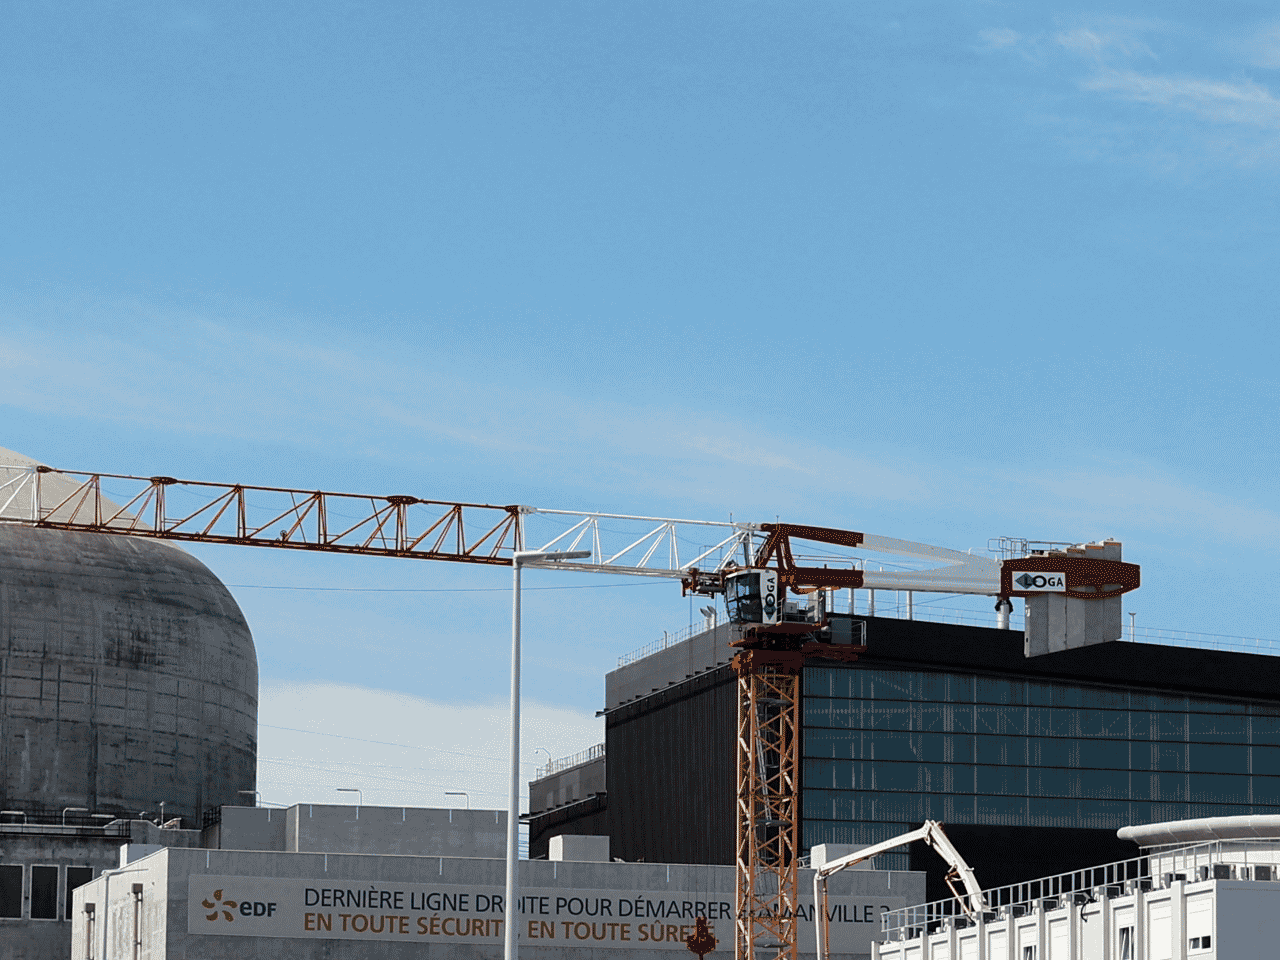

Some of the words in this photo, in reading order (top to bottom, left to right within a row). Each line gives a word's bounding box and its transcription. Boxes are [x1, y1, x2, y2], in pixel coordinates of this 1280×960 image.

[1024, 575, 1064, 588] LOGA
[304, 886, 404, 909] DERNIÈRE
[410, 892, 469, 912] LIGNE
[476, 894, 550, 915] DRITE
[556, 896, 613, 916] POUR
[619, 895, 732, 920] DÉMARRER
[304, 912, 332, 932] EN
[339, 913, 410, 935] TOUTE
[417, 913, 520, 939] SÉCURIT,
[528, 920, 555, 939] EN
[561, 921, 631, 941] TOUTE
